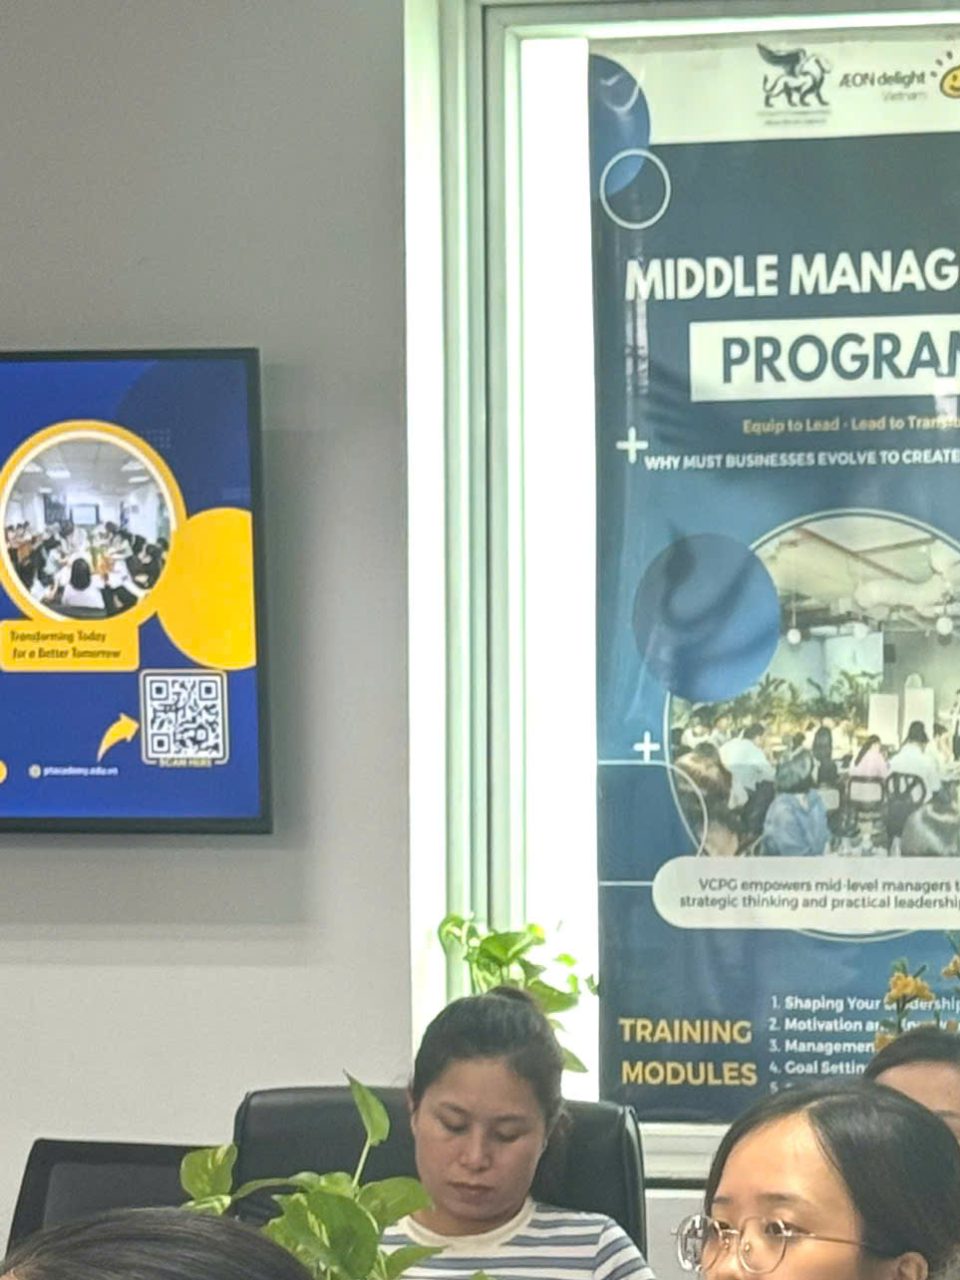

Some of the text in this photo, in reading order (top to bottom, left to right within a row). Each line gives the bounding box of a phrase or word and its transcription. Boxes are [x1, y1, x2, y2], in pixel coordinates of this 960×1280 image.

[878, 70, 926, 91] delight
[625, 254, 779, 300] MIDDLE
[742, 418, 786, 435] Equip
[787, 418, 803, 432] to
[805, 416, 840, 432] Lead
[850, 416, 886, 431] Lead
[889, 415, 905, 430] to
[645, 455, 680, 470] WHY
[683, 454, 723, 469] MUST
[725, 453, 815, 468] BUSINESSES
[818, 451, 876, 466] EVOLVE
[880, 451, 900, 465] TO
[10, 630, 106, 643] Transforming Today
[71, 647, 121, 658] Tomorrow
[699, 878, 738, 892] VCPG
[741, 880, 812, 893] empowers
[814, 877, 879, 892] mid-level
[882, 879, 951, 894] managers
[680, 896, 739, 910] strategic
[742, 895, 799, 911] thinking
[802, 896, 828, 908] and
[831, 895, 891, 911] practical
[784, 995, 845, 1013] Shaping
[847, 996, 881, 1010] Your
[618, 1018, 752, 1044] TRAINING
[768, 1017, 781, 1032] 2.
[784, 1016, 863, 1032] Motivation
[769, 1038, 876, 1057] 3. Managemen
[621, 1060, 758, 1086] MODULES
[769, 1060, 868, 1075] 4. Goal Settin
